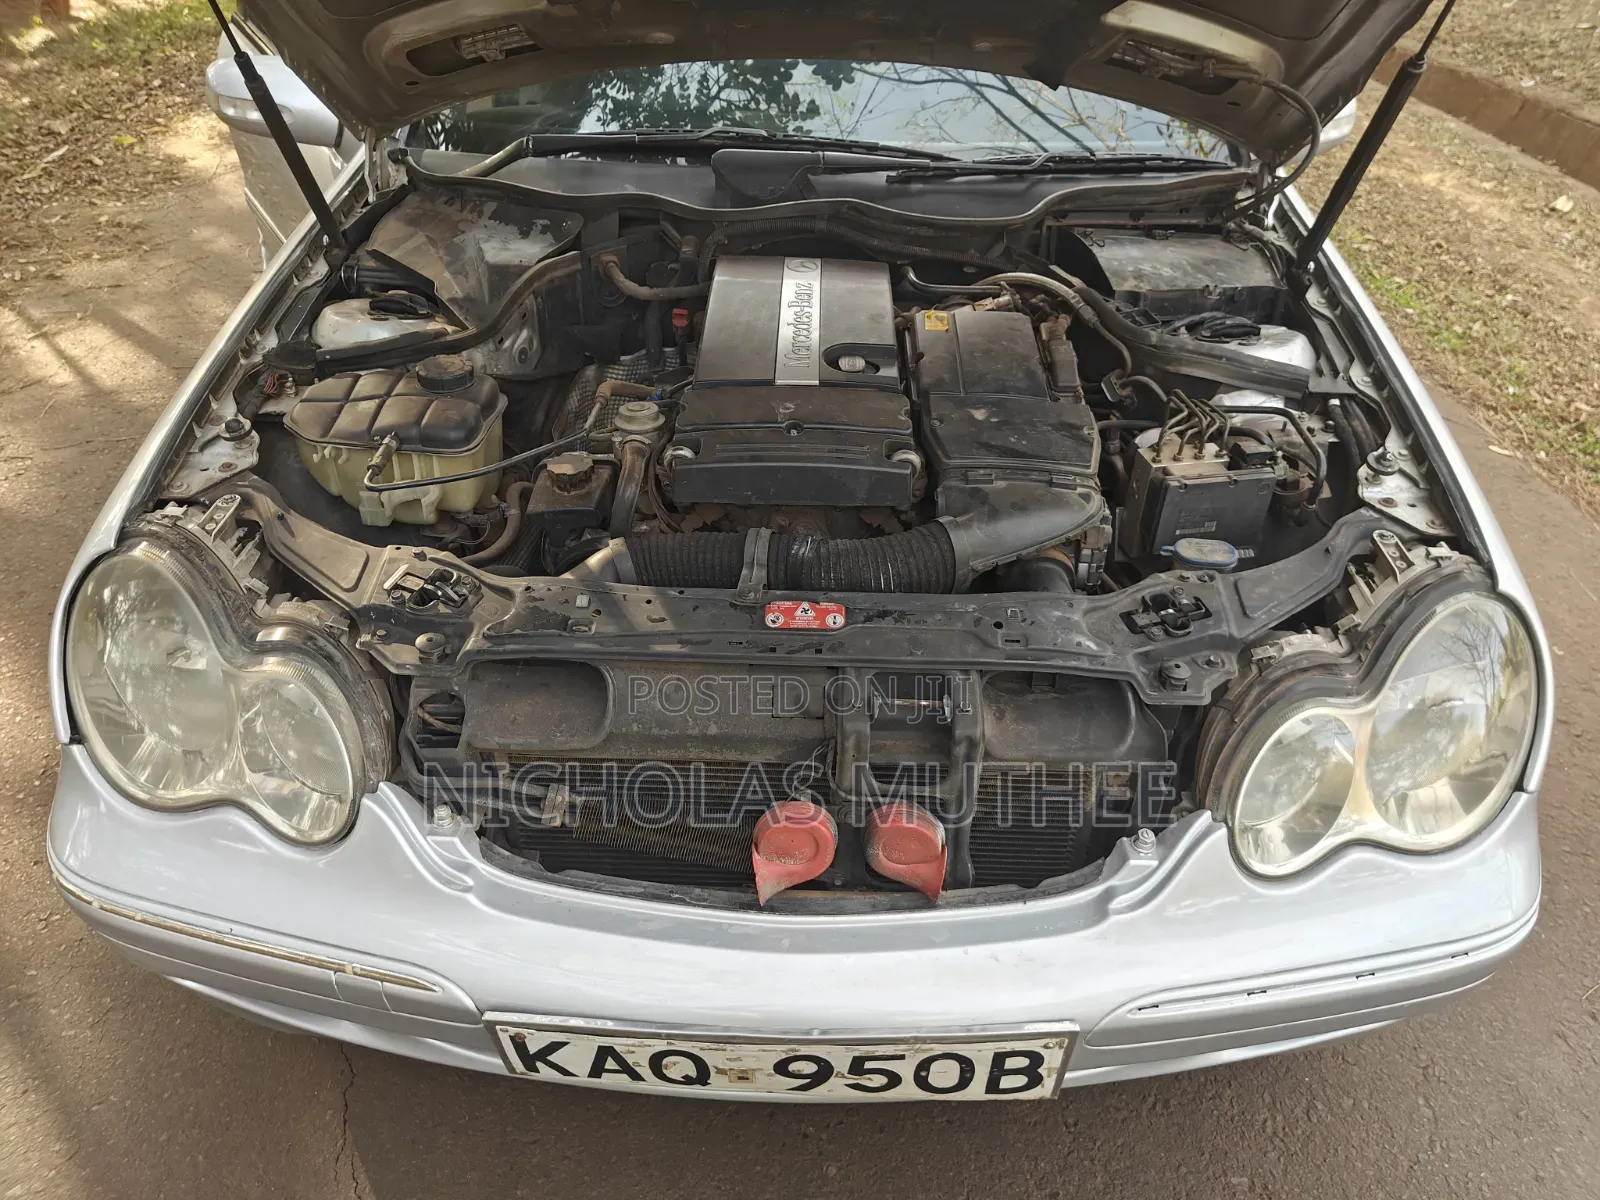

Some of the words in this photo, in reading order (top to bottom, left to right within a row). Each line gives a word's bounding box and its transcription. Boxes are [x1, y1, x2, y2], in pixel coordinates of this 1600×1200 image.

[784, 281, 814, 369] Mercedes-Benz
[507, 1034, 712, 1087] KAQ
[772, 1049, 1046, 1095] 950B
